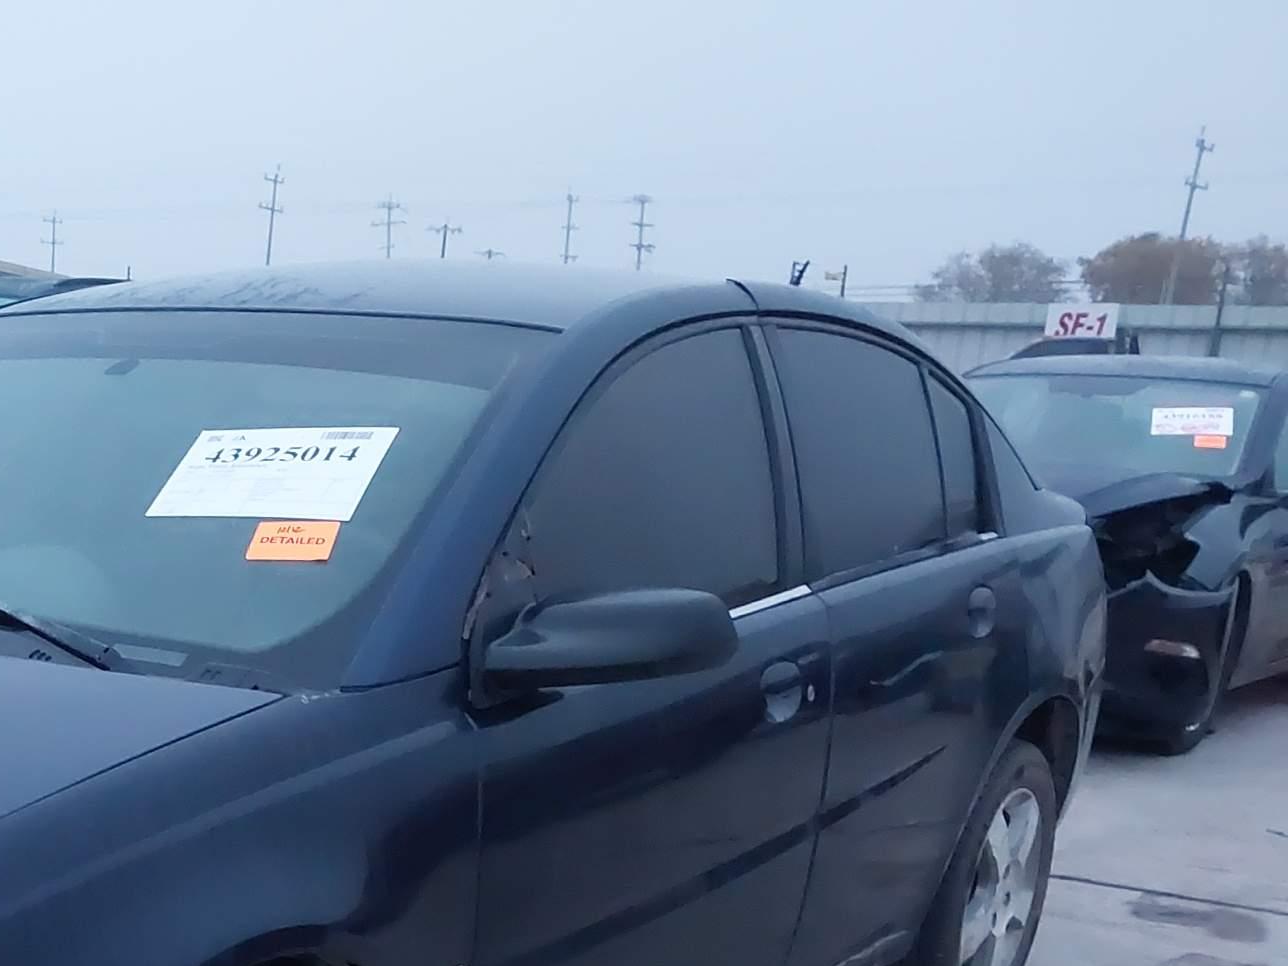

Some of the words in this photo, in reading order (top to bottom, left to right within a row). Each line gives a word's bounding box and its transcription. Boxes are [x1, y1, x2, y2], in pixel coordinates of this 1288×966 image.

[1054, 312, 1108, 336] SF-1
[205, 445, 360, 463] 43925014
[259, 536, 326, 545] DETAILED
